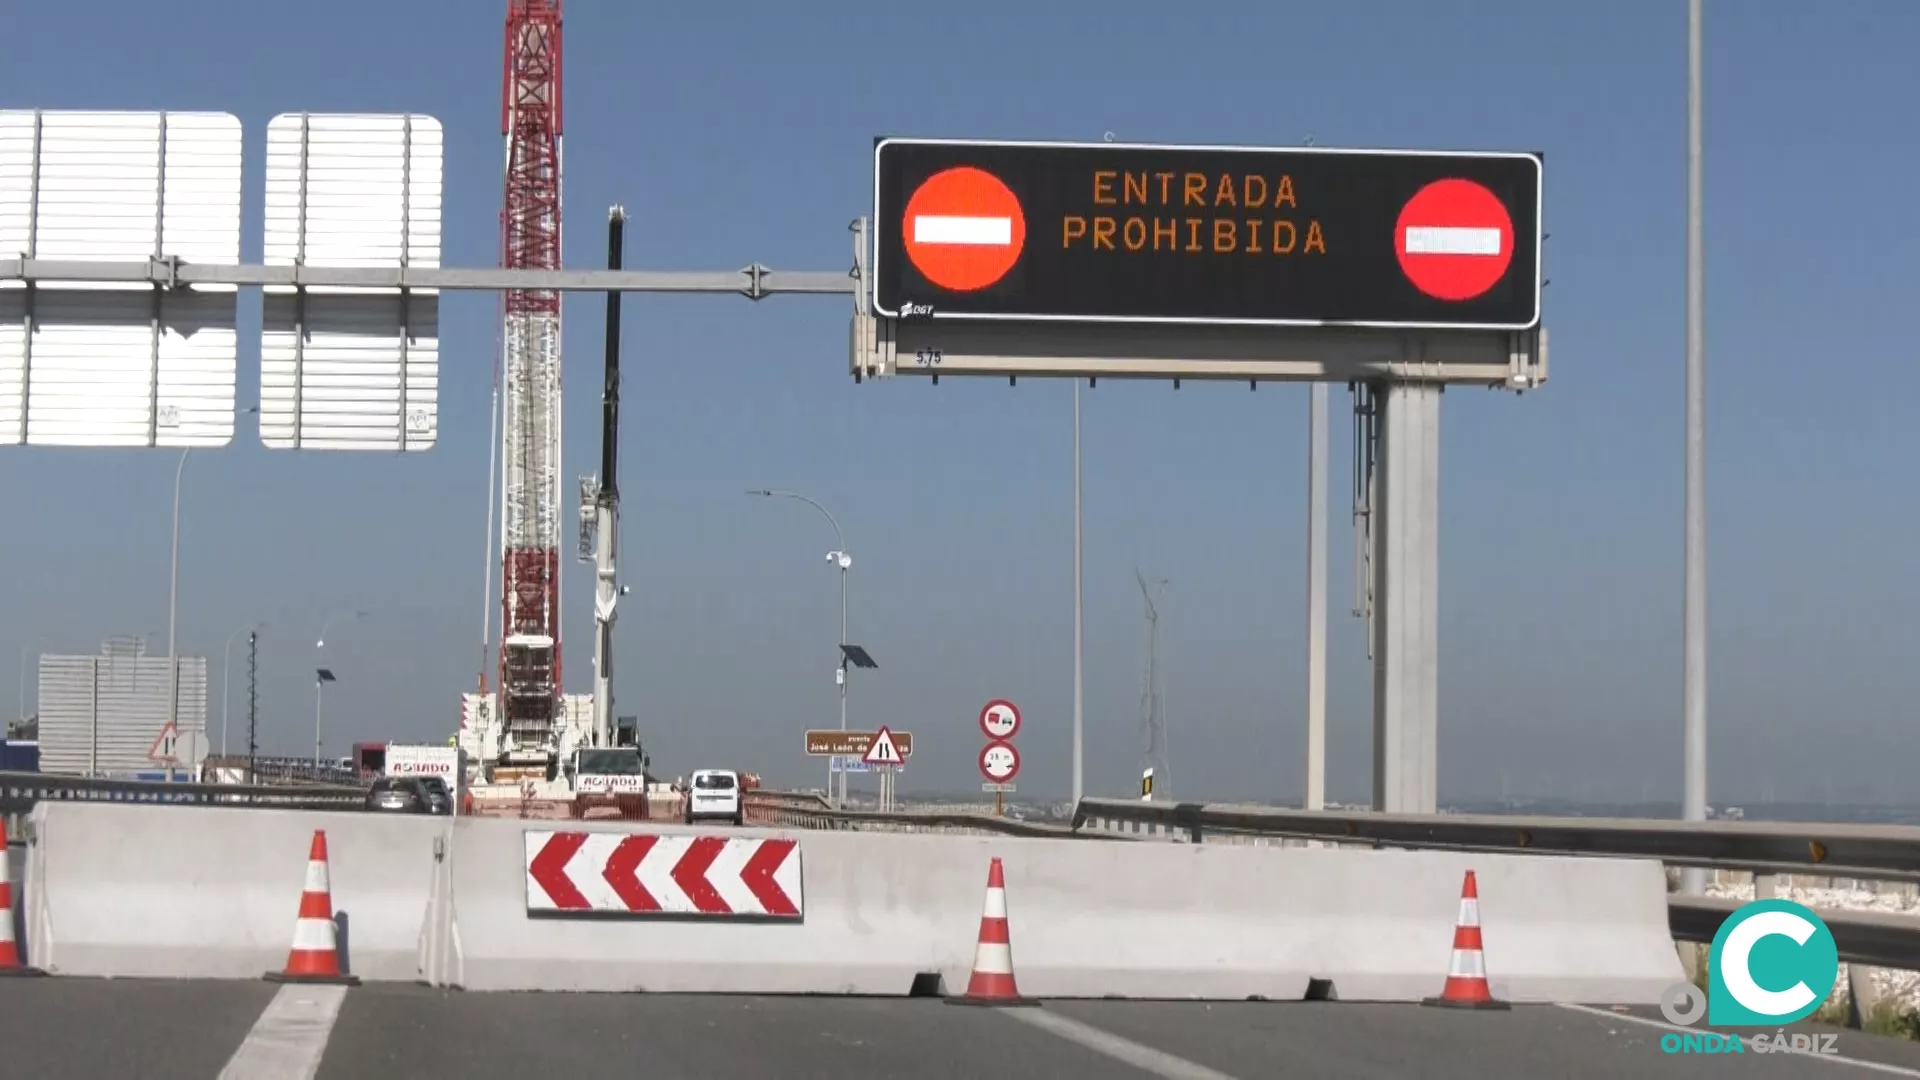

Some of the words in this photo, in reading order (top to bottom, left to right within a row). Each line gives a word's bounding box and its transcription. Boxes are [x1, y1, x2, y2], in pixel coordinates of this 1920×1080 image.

[1094, 170, 1298, 209] ENTRADA
[1062, 215, 1327, 255] PROHIBIDA
[913, 304, 934, 315] DGT
